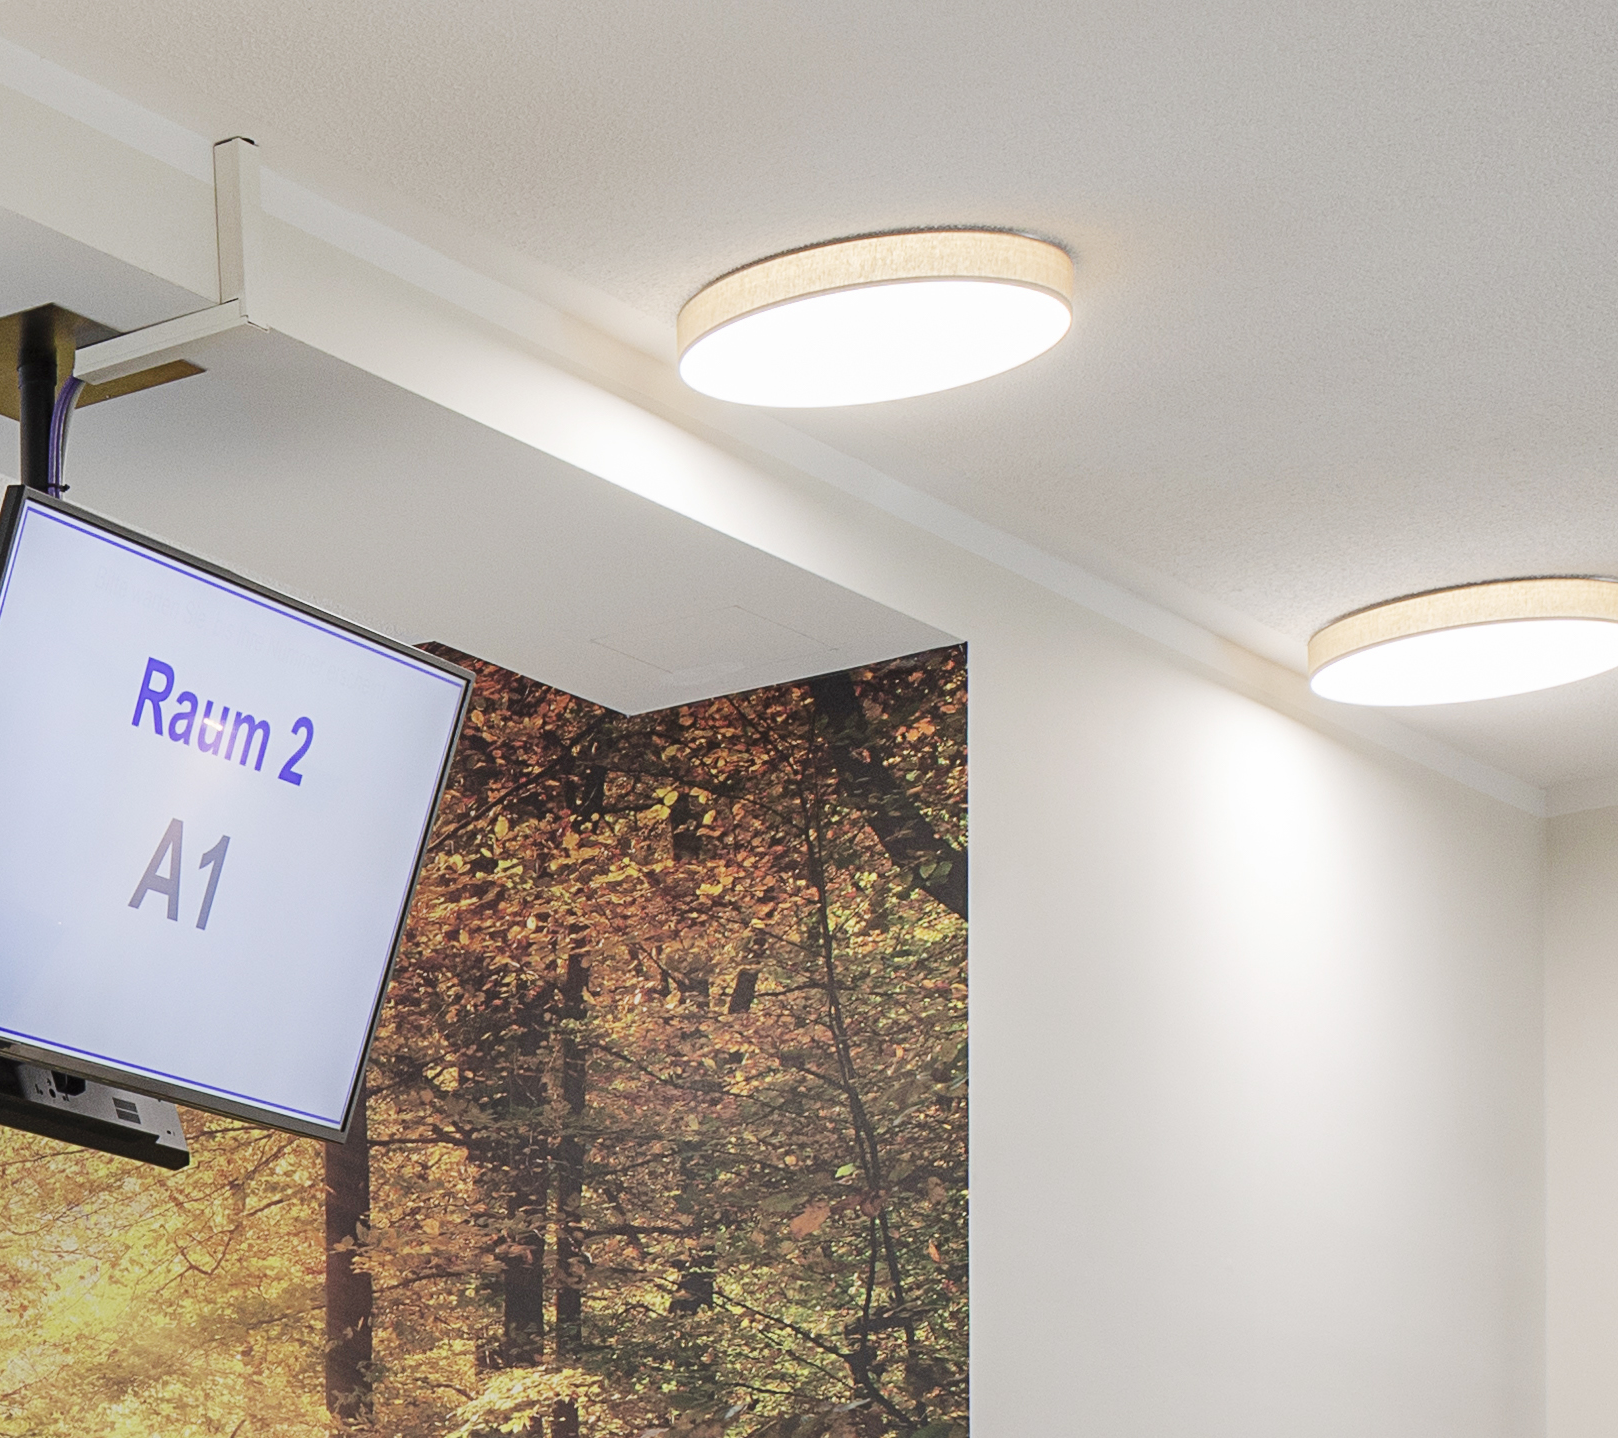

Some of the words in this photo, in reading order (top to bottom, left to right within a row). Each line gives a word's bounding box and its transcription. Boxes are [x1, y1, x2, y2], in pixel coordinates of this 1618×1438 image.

[131, 656, 271, 771] Raum
[278, 716, 315, 786] 2
[127, 817, 231, 930] A1
